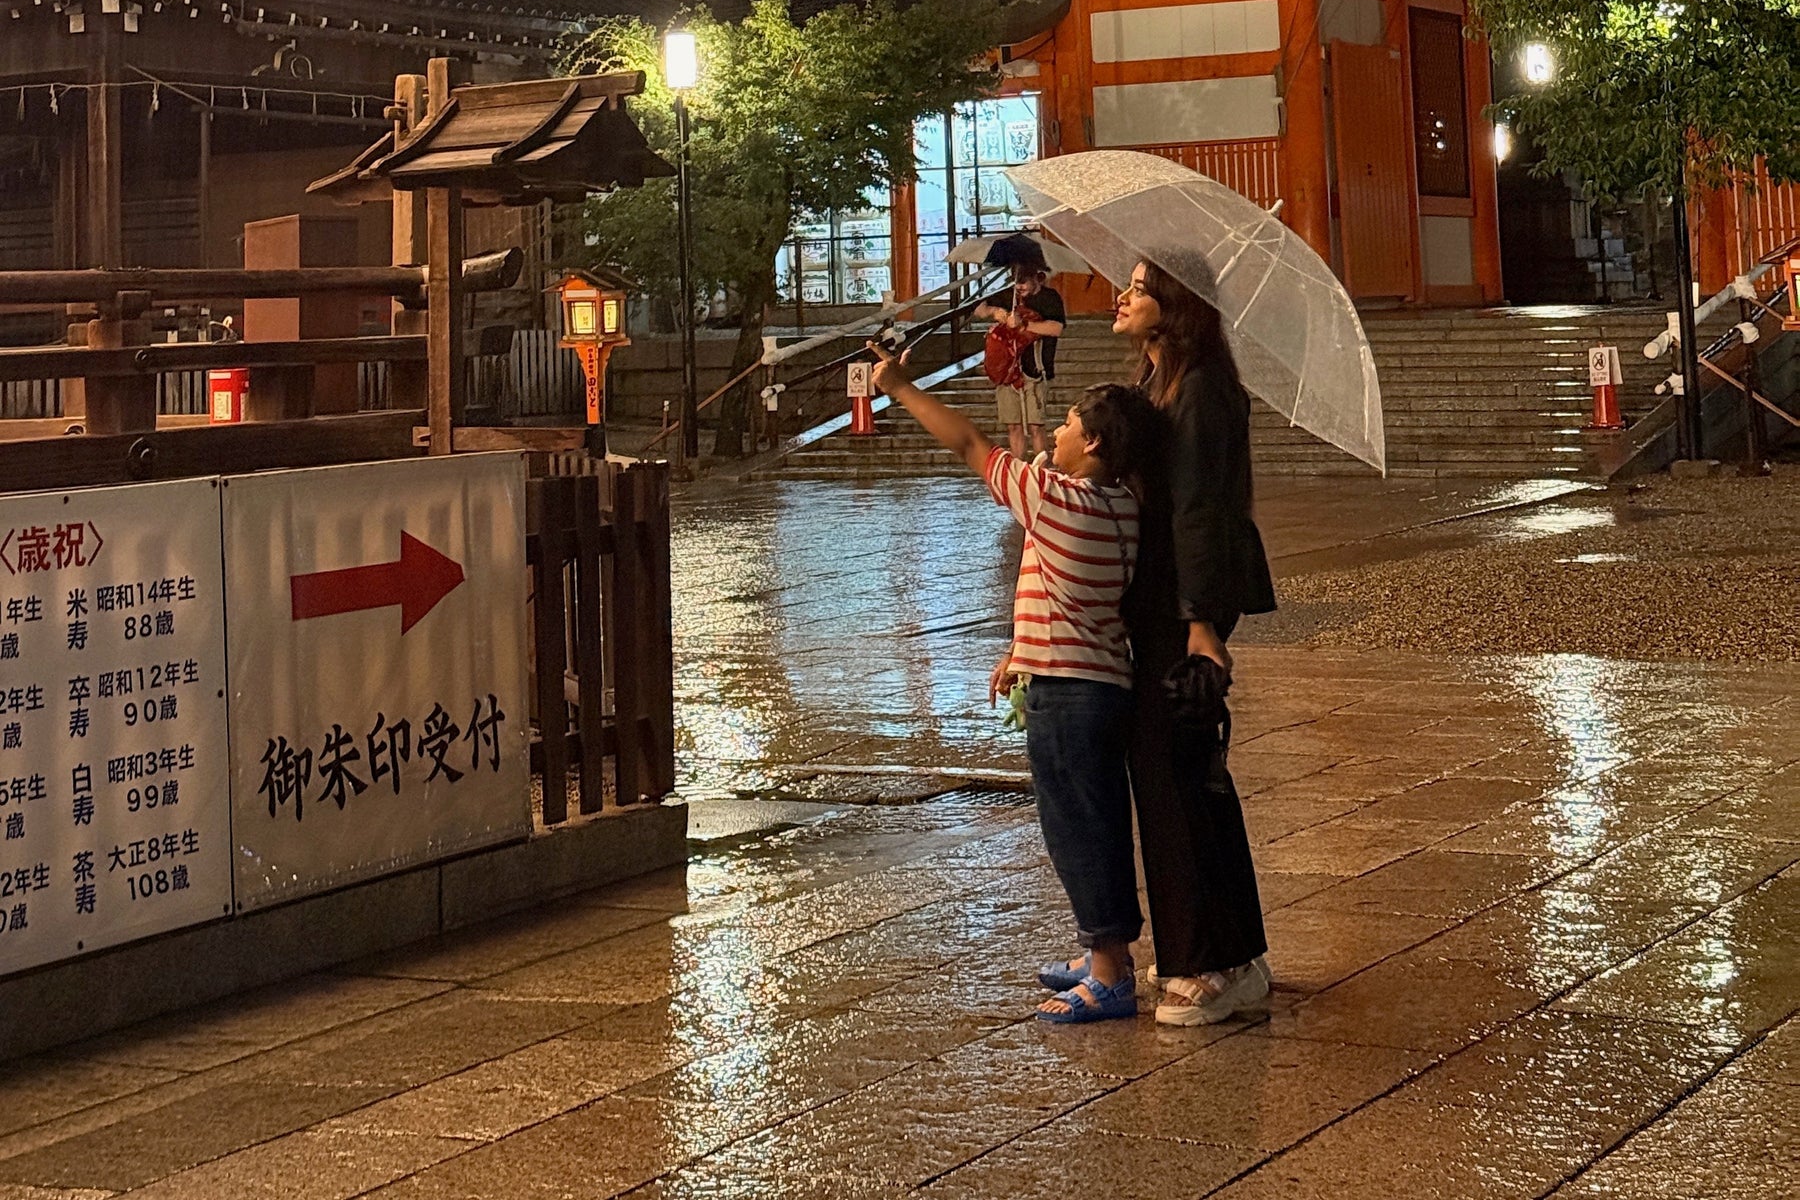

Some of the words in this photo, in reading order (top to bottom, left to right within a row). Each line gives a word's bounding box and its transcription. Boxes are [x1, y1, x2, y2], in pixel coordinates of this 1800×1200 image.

[96, 574, 197, 613] 昭和14年生
[66, 587, 89, 651] 米寿
[123, 609, 175, 641] 88歳
[97, 657, 200, 699] 昭和12年生
[68, 674, 91, 738] 卒寿
[123, 694, 179, 727] 90歳
[107, 743, 196, 784] 昭和3年生
[257, 692, 506, 823] 御朱印受付
[72, 762, 95, 826] 白寿
[126, 779, 180, 813] 99歳
[0, 811, 26, 841] 歳
[107, 827, 201, 873] 大正8年生
[72, 850, 97, 915] 茶寿
[126, 863, 191, 901] 108歳
